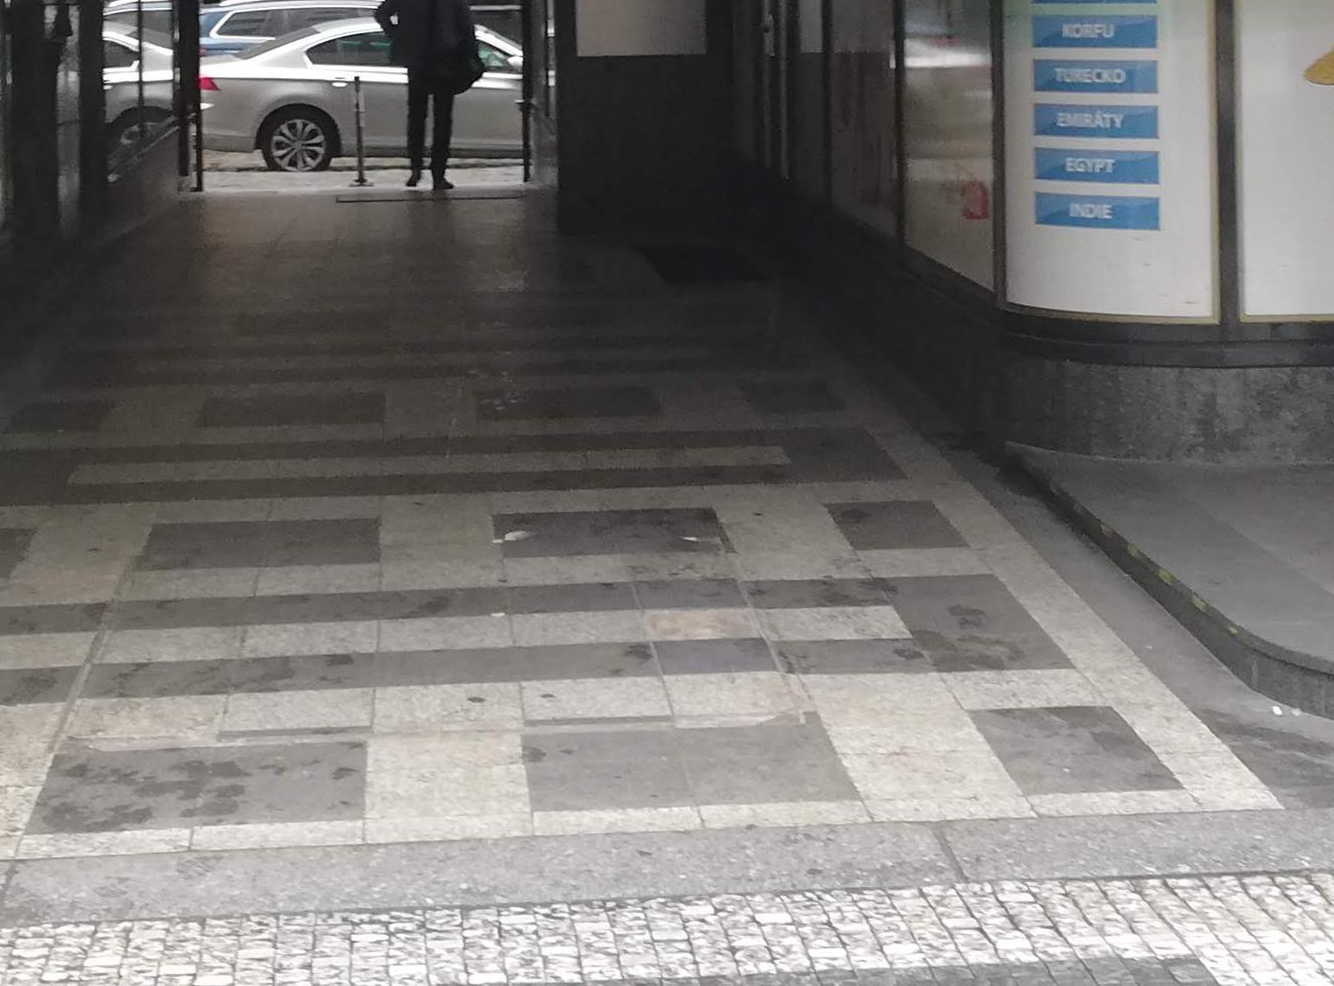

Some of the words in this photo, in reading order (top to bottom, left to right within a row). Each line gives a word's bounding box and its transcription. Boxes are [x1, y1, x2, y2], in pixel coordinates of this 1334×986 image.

[1062, 22, 1115, 40] KORFU
[1054, 68, 1127, 84] TURECKO
[1065, 158, 1115, 174] EGYPT
[1069, 203, 1113, 220] INDIE
